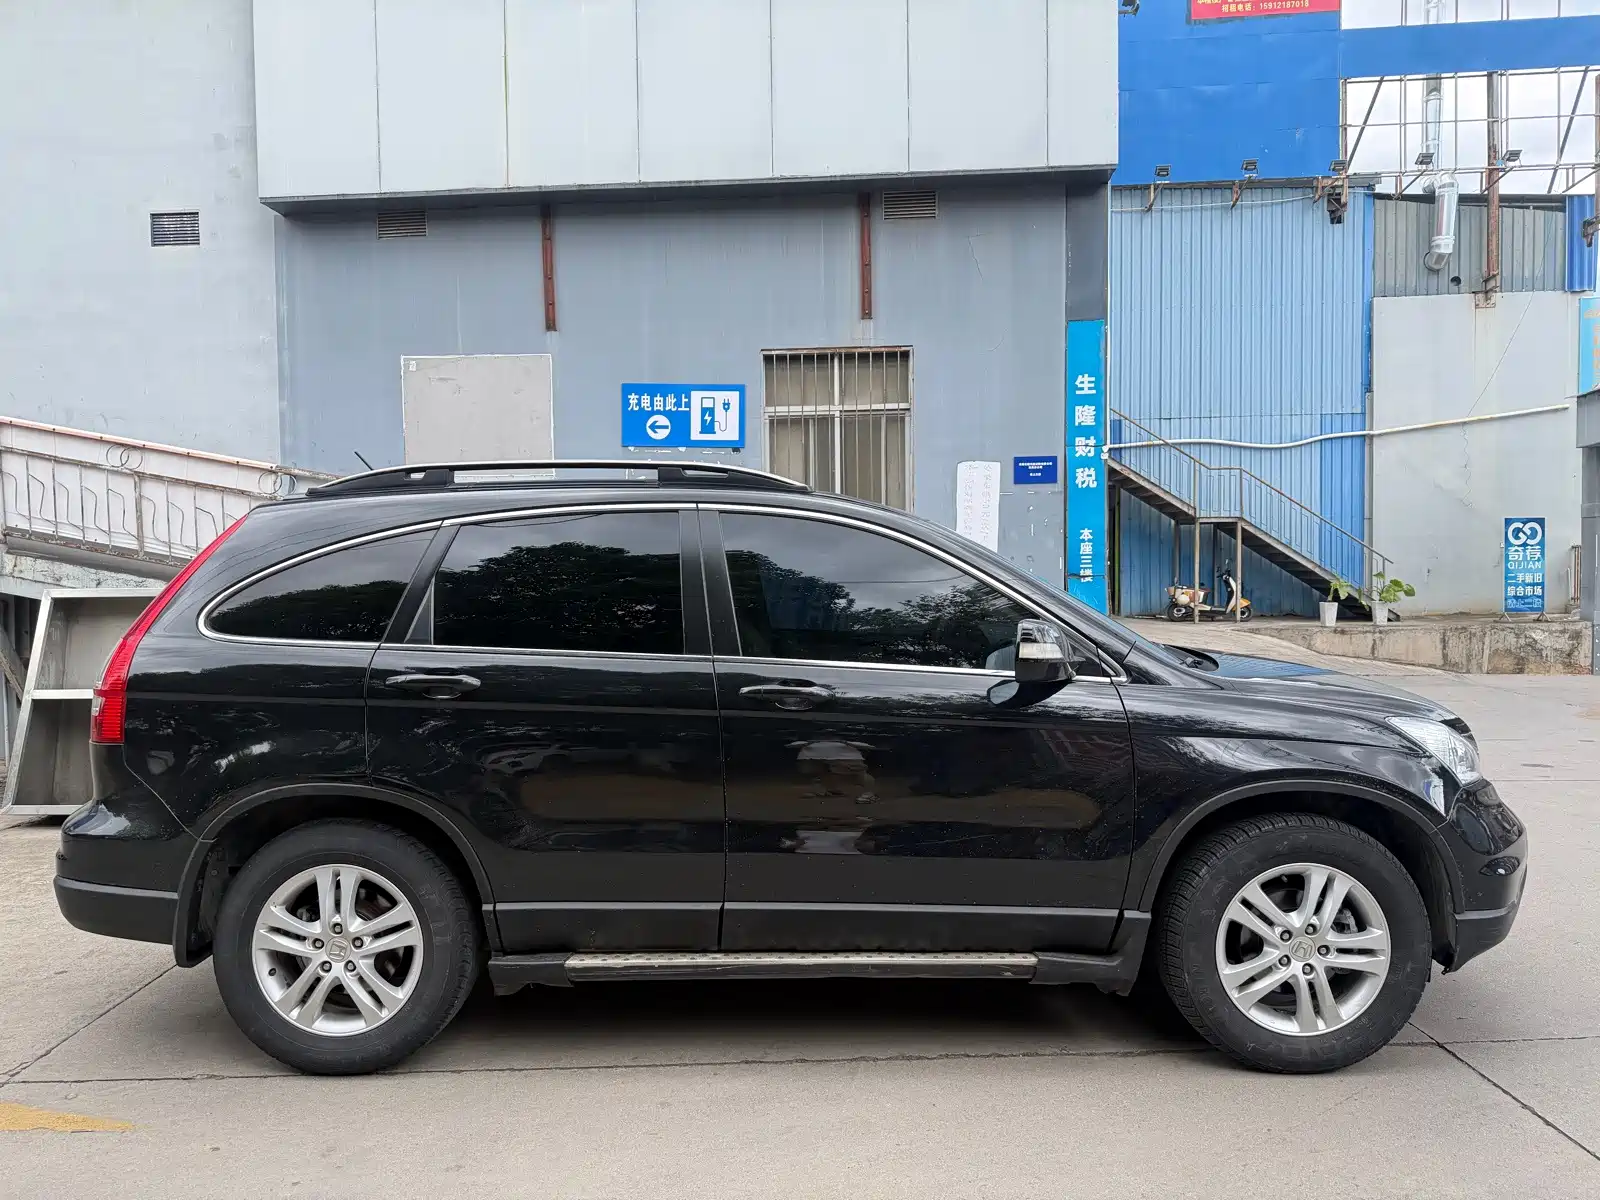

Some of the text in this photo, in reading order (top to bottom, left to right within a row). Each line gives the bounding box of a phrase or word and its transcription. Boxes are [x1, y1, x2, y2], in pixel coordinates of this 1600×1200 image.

[627, 393, 690, 412] 充电由此上
[1074, 373, 1098, 489] 生隆财税
[1079, 528, 1093, 583] 本座三楼
[1508, 546, 1542, 561] 奇荐
[1507, 561, 1542, 570] QIJIAN
[1507, 573, 1543, 584] 二手新旧
[1507, 586, 1543, 596] 综合市场
